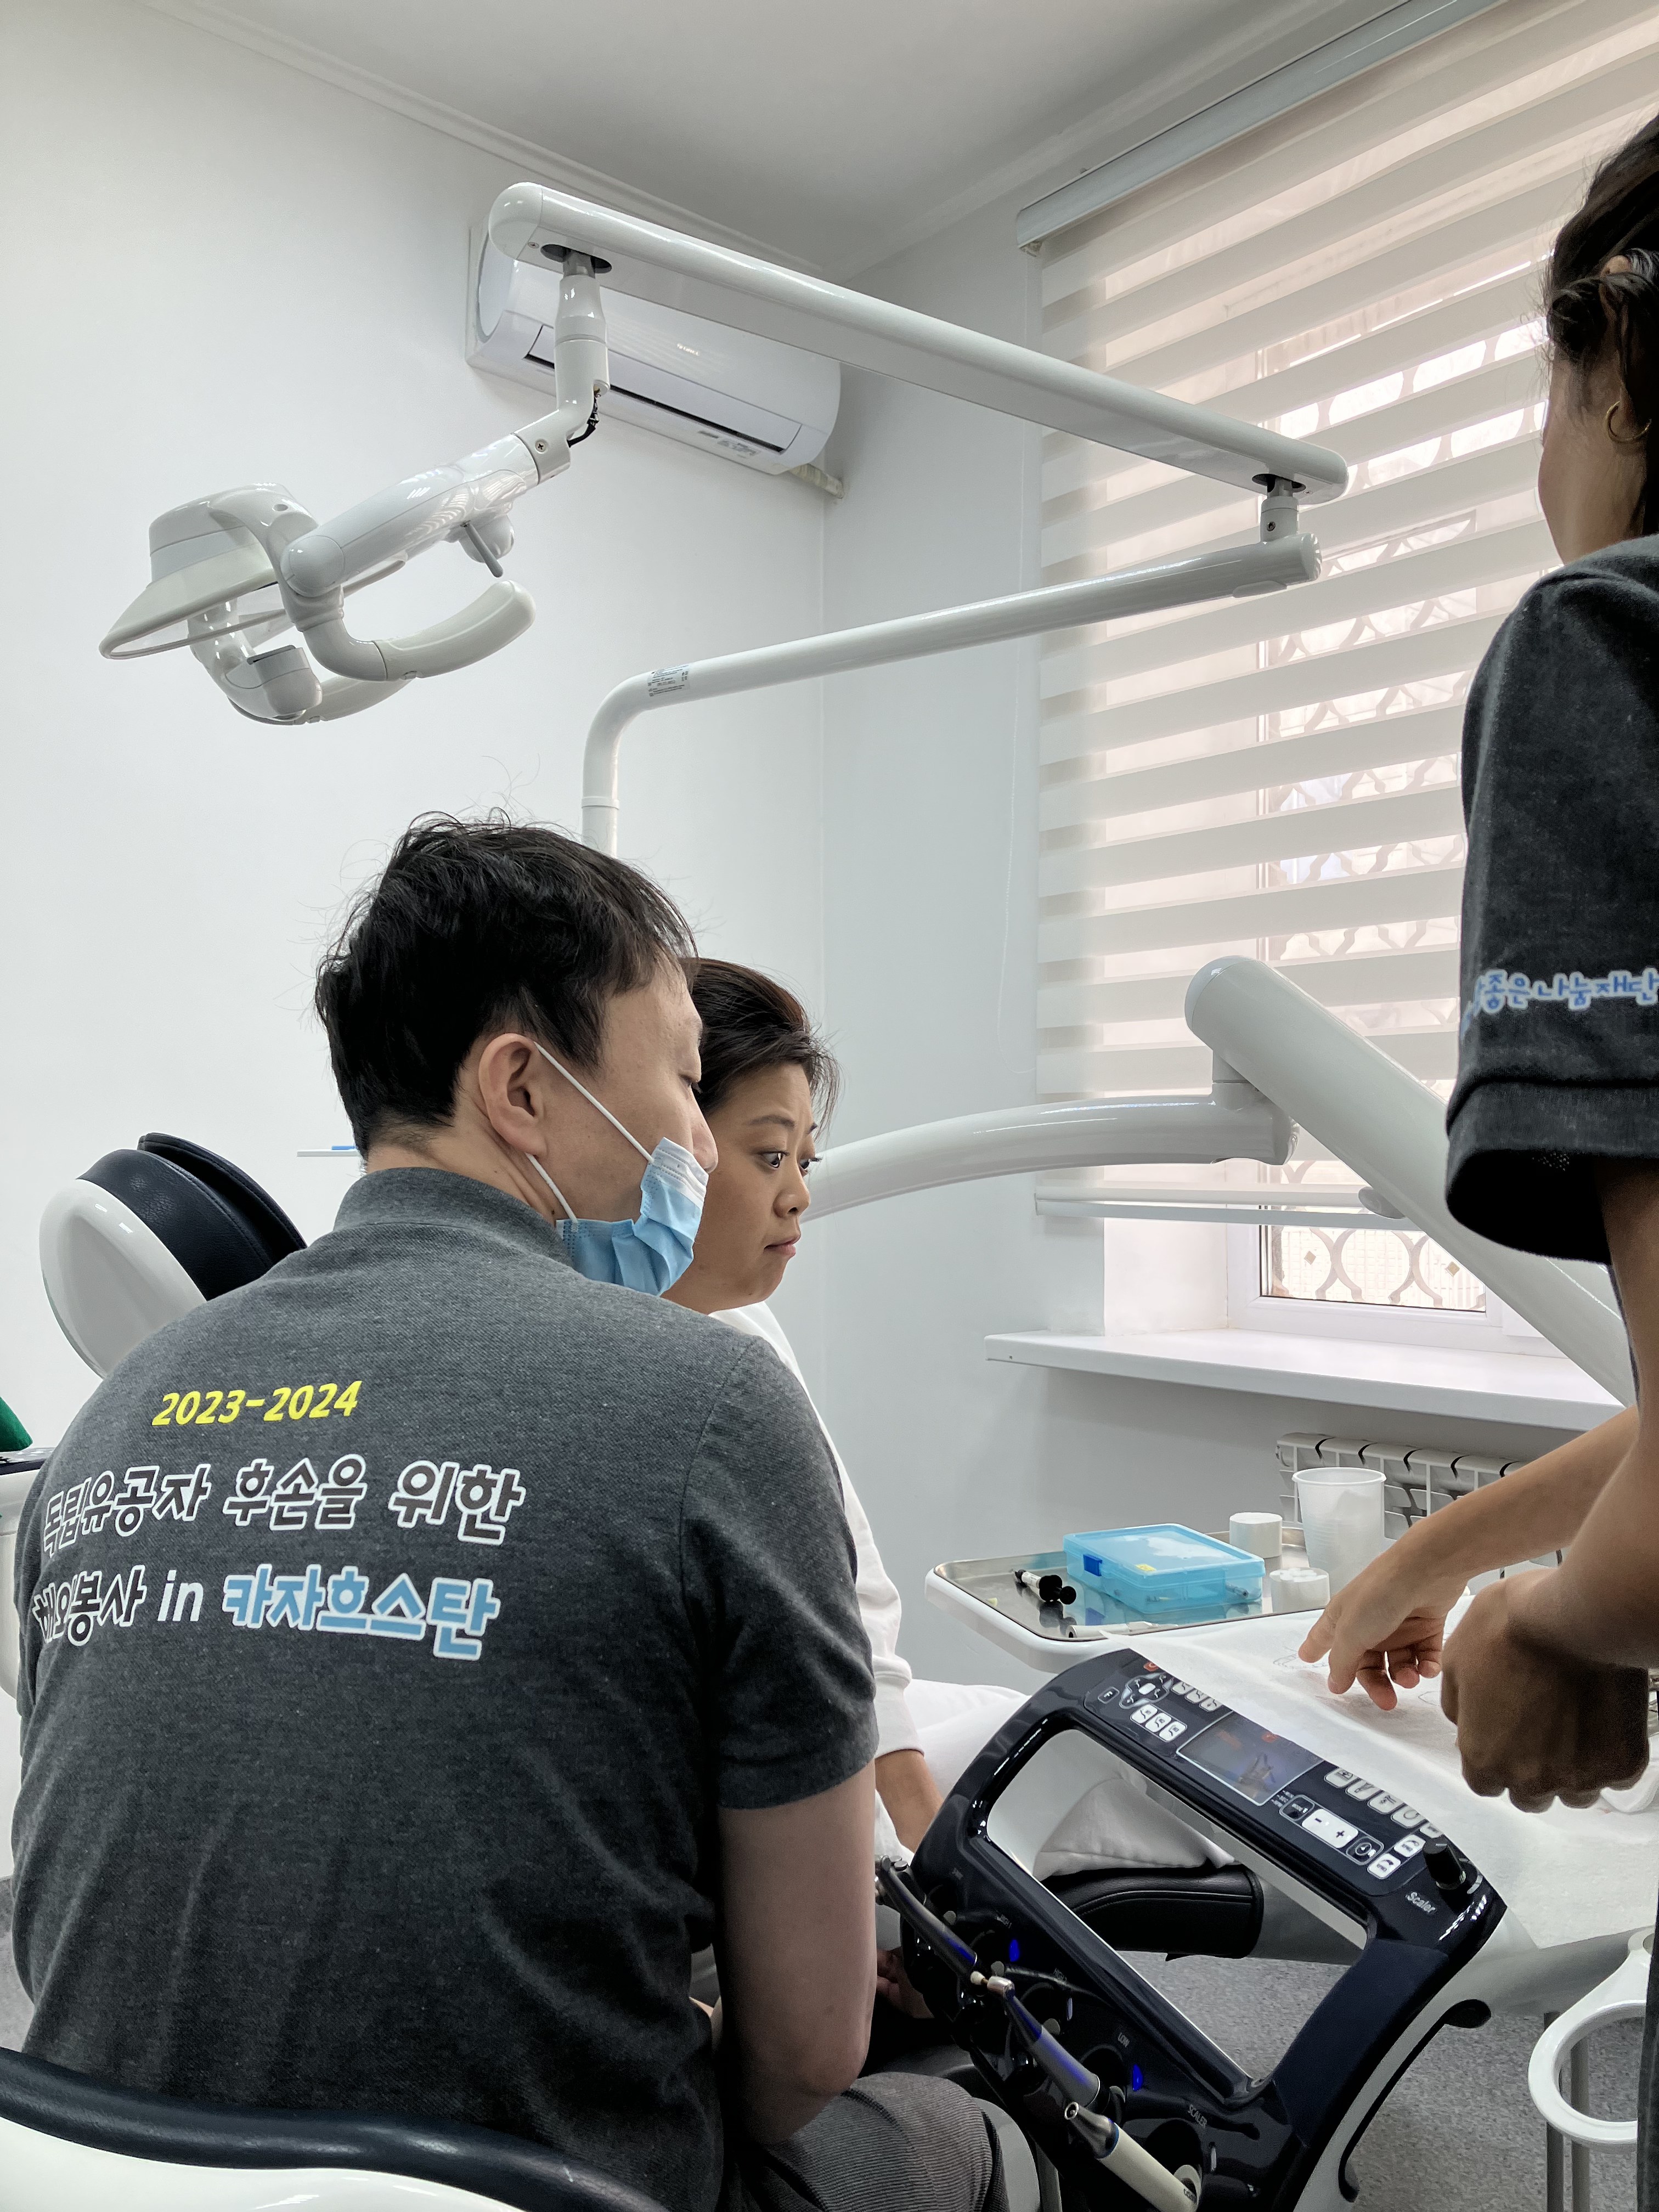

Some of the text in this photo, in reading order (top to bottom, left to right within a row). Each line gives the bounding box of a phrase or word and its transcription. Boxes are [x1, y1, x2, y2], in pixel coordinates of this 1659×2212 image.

[152, 1381, 362, 1425] 2023-2024
[43, 1453, 527, 1559] 독립유공자 후손을 위한
[32, 1564, 501, 1661] 해외봉사 in 카자흐스탄
[1405, 1892, 1436, 1914] Scaler
[1118, 2032, 1130, 2048] LOW
[1188, 2103, 1207, 2129] SCALER
